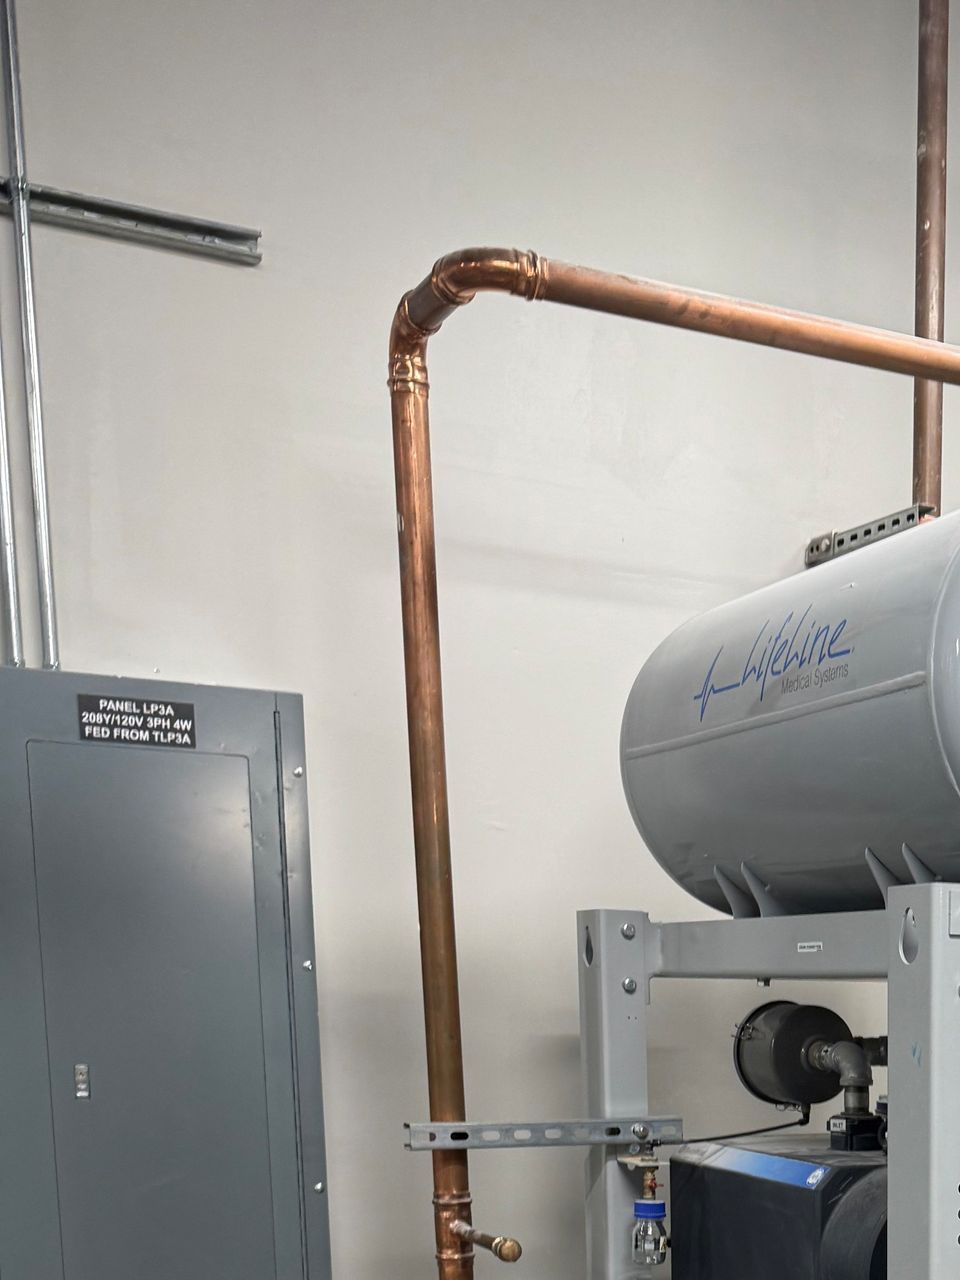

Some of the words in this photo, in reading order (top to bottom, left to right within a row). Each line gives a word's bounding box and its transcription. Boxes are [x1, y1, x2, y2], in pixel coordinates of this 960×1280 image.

[781, 674, 813, 695] Medical
[814, 663, 849, 688] Systems
[99, 699, 140, 714] PANEL
[143, 702, 175, 717] LP3A
[81, 711, 143, 728] 208Y/120V
[146, 717, 171, 730] 3PH
[173, 718, 192, 731] 4W
[85, 725, 110, 739] FED
[113, 727, 150, 742] FROM
[152, 730, 191, 745] TLP3A
